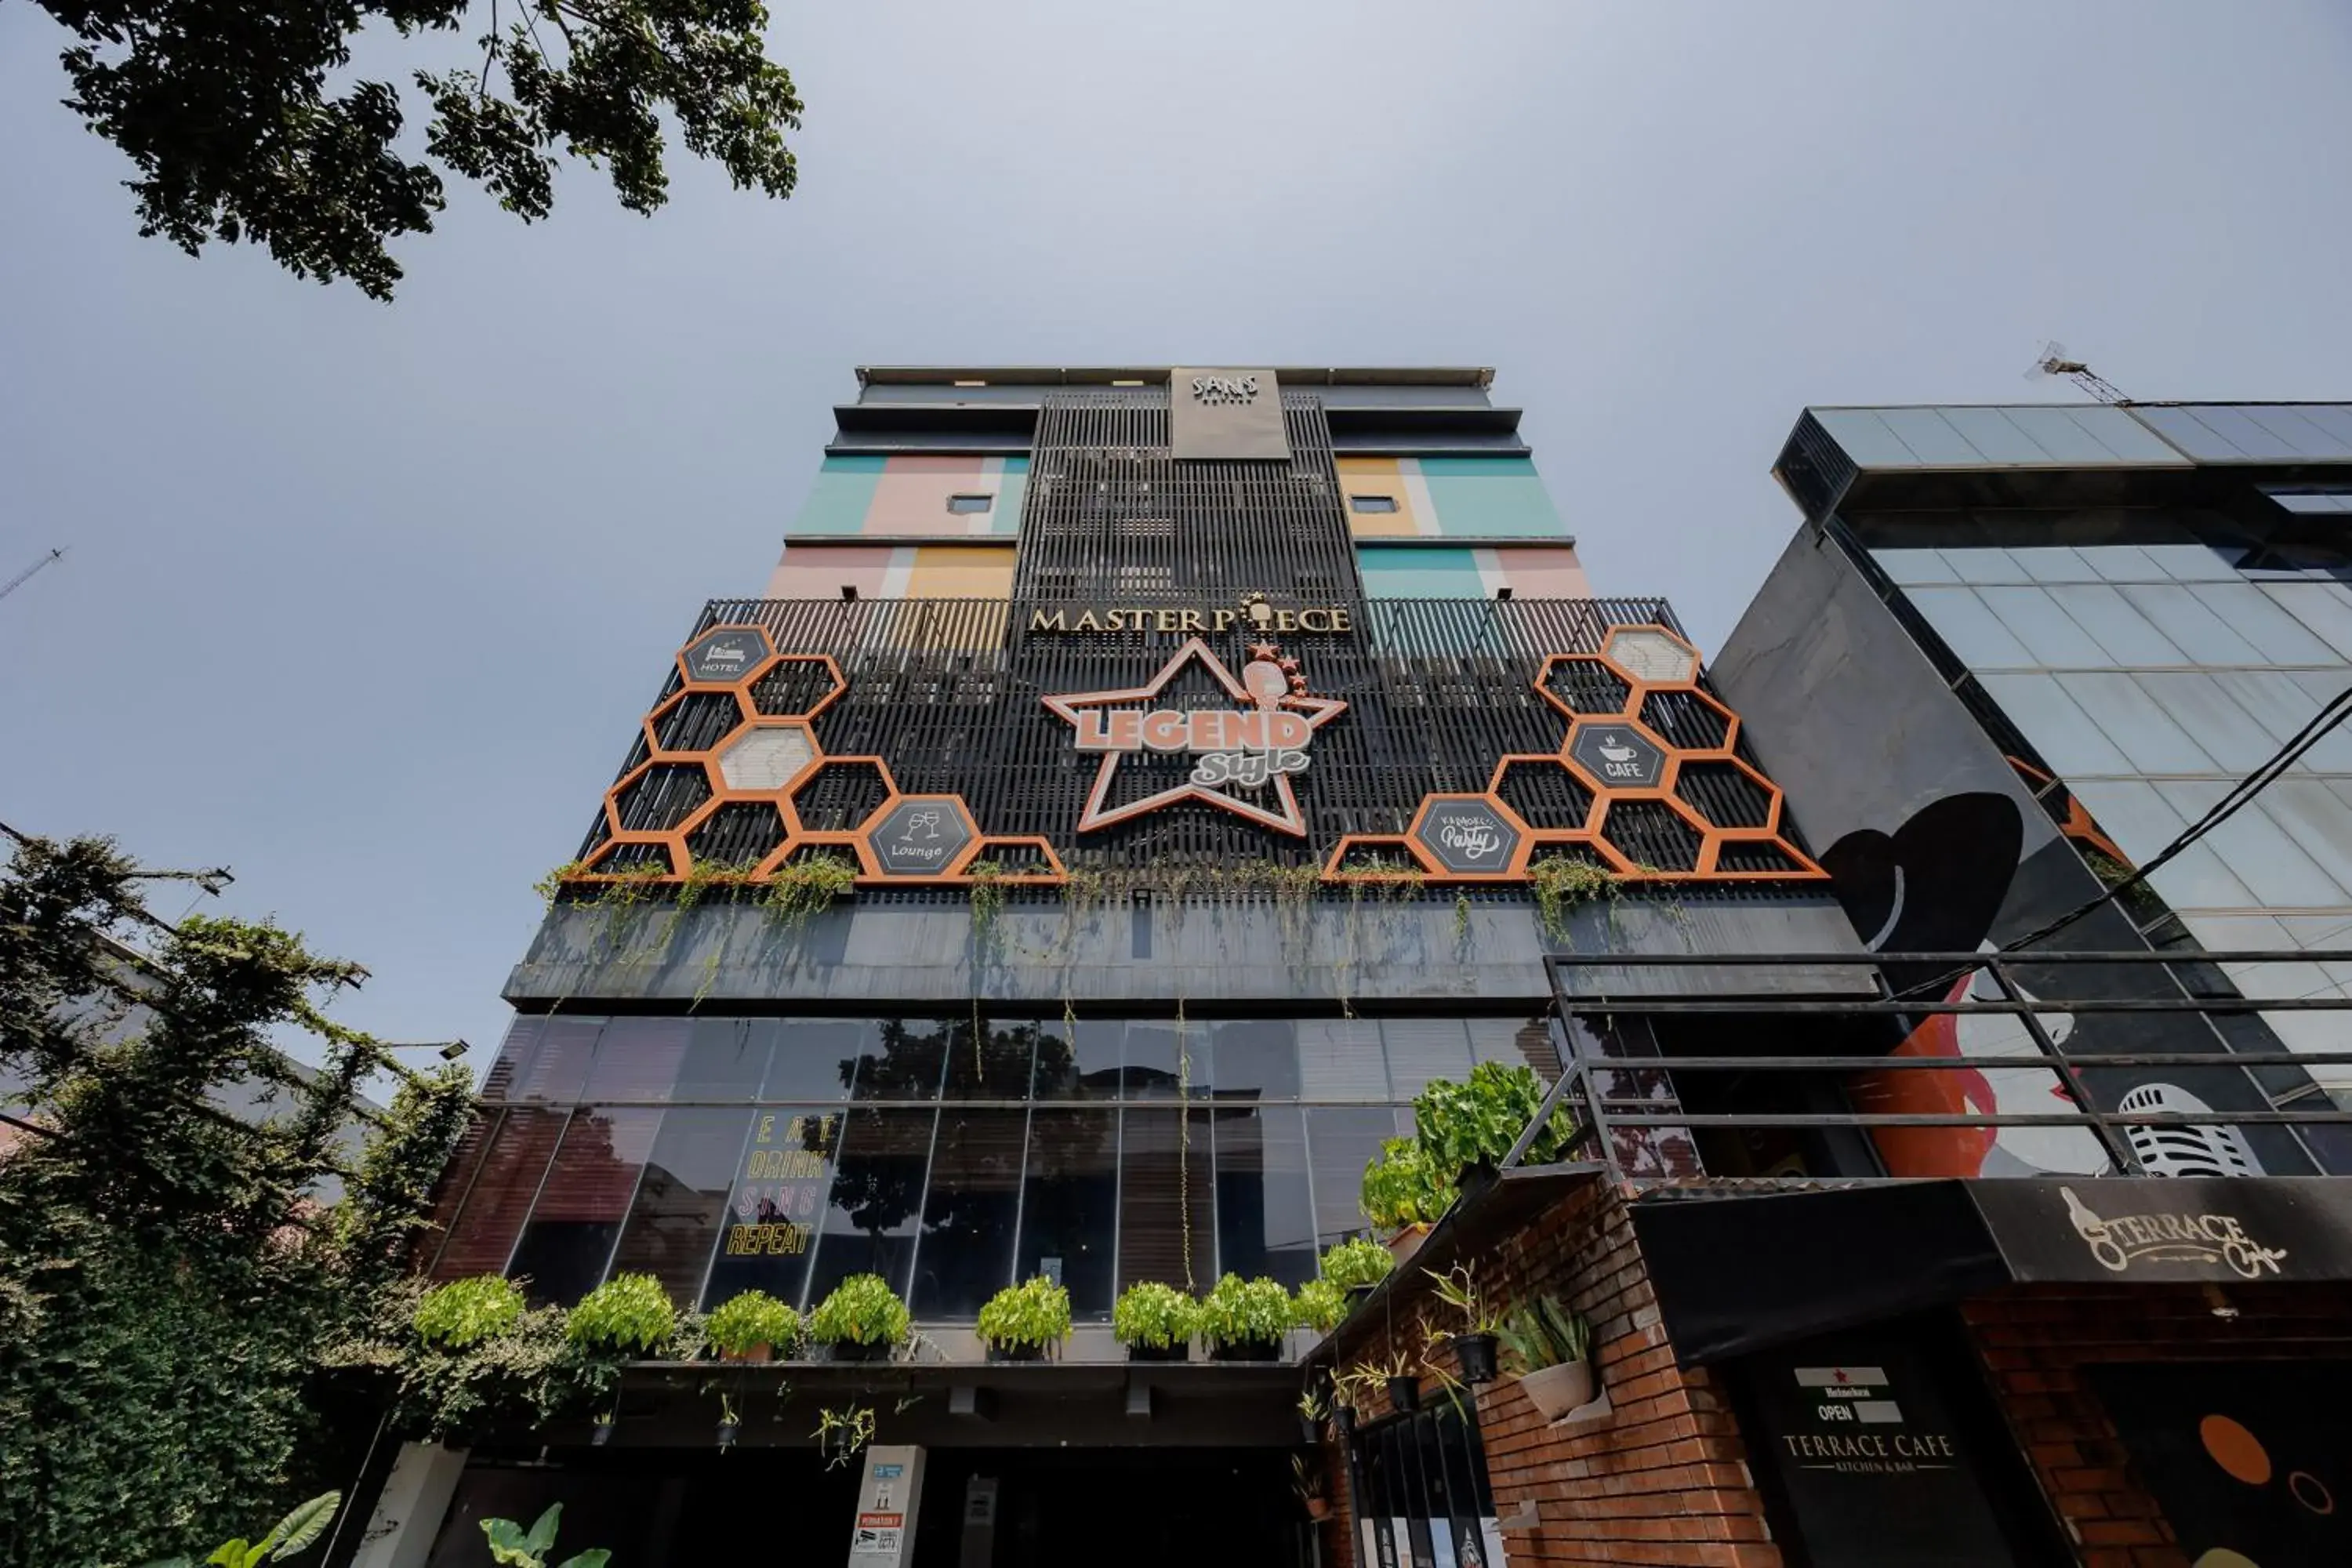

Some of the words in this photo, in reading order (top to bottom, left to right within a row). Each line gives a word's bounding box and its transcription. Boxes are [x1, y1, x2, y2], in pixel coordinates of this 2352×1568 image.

[1191, 376, 1258, 396] SANS
[699, 663, 741, 672] HOTEL
[1075, 709, 1313, 753] LEGEND
[1190, 749, 1312, 789] Style
[1605, 762, 1643, 777] CAFE
[891, 844, 942, 860] Lounge
[1440, 826, 1500, 859] Party
[757, 1116, 835, 1142] EAT
[747, 1150, 828, 1179] DRINK
[738, 1185, 817, 1216] SING
[726, 1223, 813, 1254] REPEAT
[2100, 1214, 2251, 1247] TERRACE
[1818, 1405, 1853, 1421] OPEN
[1782, 1436, 1889, 1457] TERRACE
[1894, 1435, 1956, 1457] CAFE
